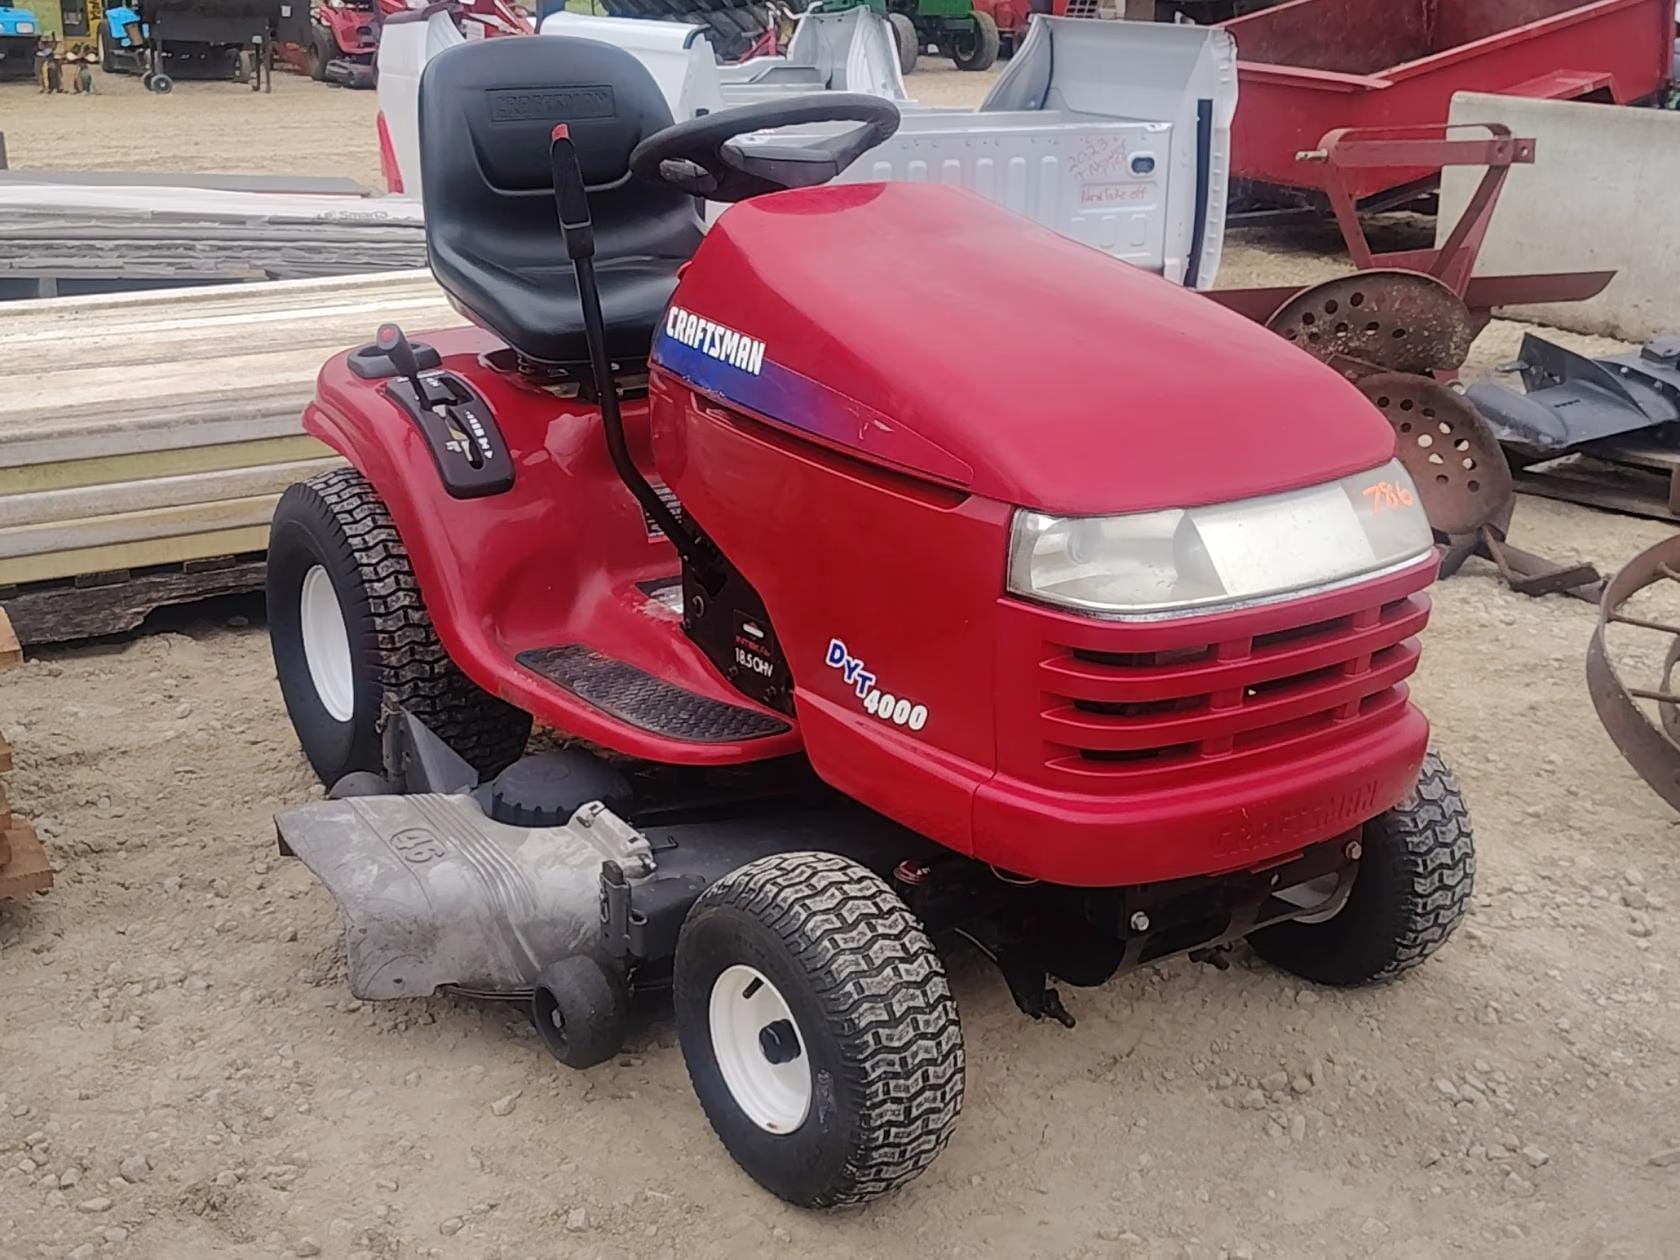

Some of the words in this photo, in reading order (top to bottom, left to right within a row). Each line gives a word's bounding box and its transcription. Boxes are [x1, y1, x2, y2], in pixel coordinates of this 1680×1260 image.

[665, 305, 767, 376] CRAFTSMAN
[1361, 482, 1414, 513] 786
[825, 638, 876, 699] DYT
[863, 689, 928, 731] 4000
